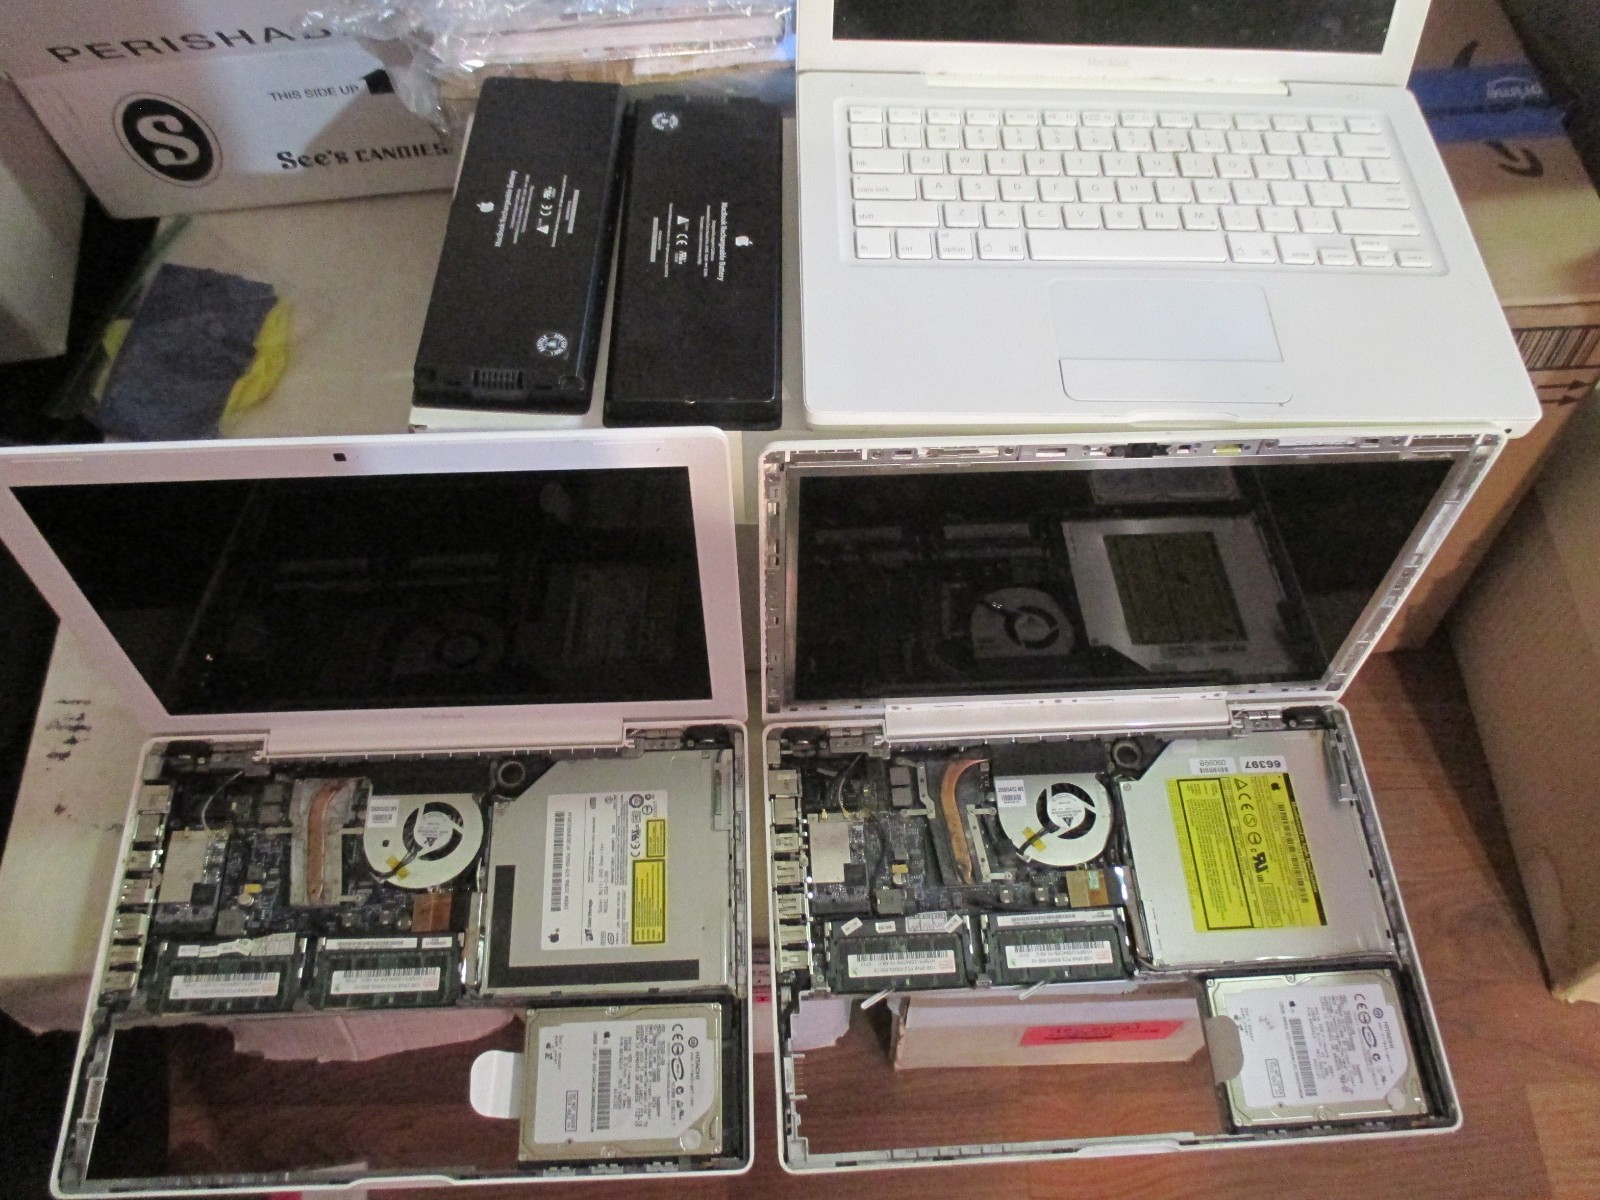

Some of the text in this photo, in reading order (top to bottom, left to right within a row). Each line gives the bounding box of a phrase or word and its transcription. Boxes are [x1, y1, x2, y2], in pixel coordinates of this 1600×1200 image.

[270, 84, 359, 101] THIS SIDE UP
[277, 149, 349, 169] See's
[1244, 759, 1282, 770] 66397
